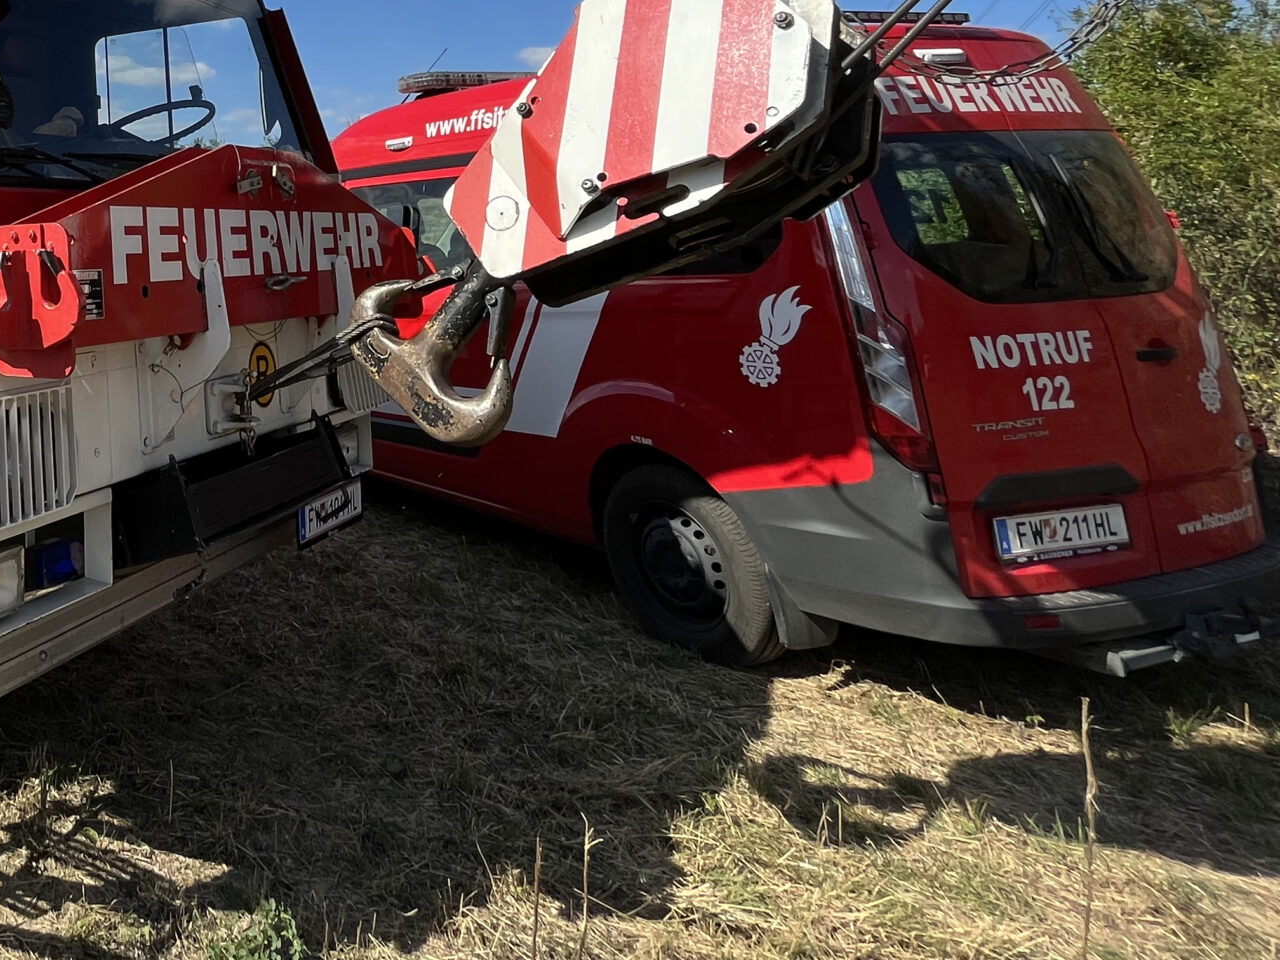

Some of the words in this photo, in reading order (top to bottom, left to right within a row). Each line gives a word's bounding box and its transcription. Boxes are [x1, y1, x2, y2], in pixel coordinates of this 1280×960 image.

[874, 74, 1082, 115] FEUERWEHR
[426, 106, 508, 138] www.ffsit
[109, 205, 383, 285] FEUERWEHR
[969, 330, 1094, 369] NOTRUF
[1022, 376, 1075, 411] 122
[971, 416, 1047, 432] TRANSIT
[1002, 430, 1050, 441] CUSTOM
[1015, 519, 1045, 548] FW
